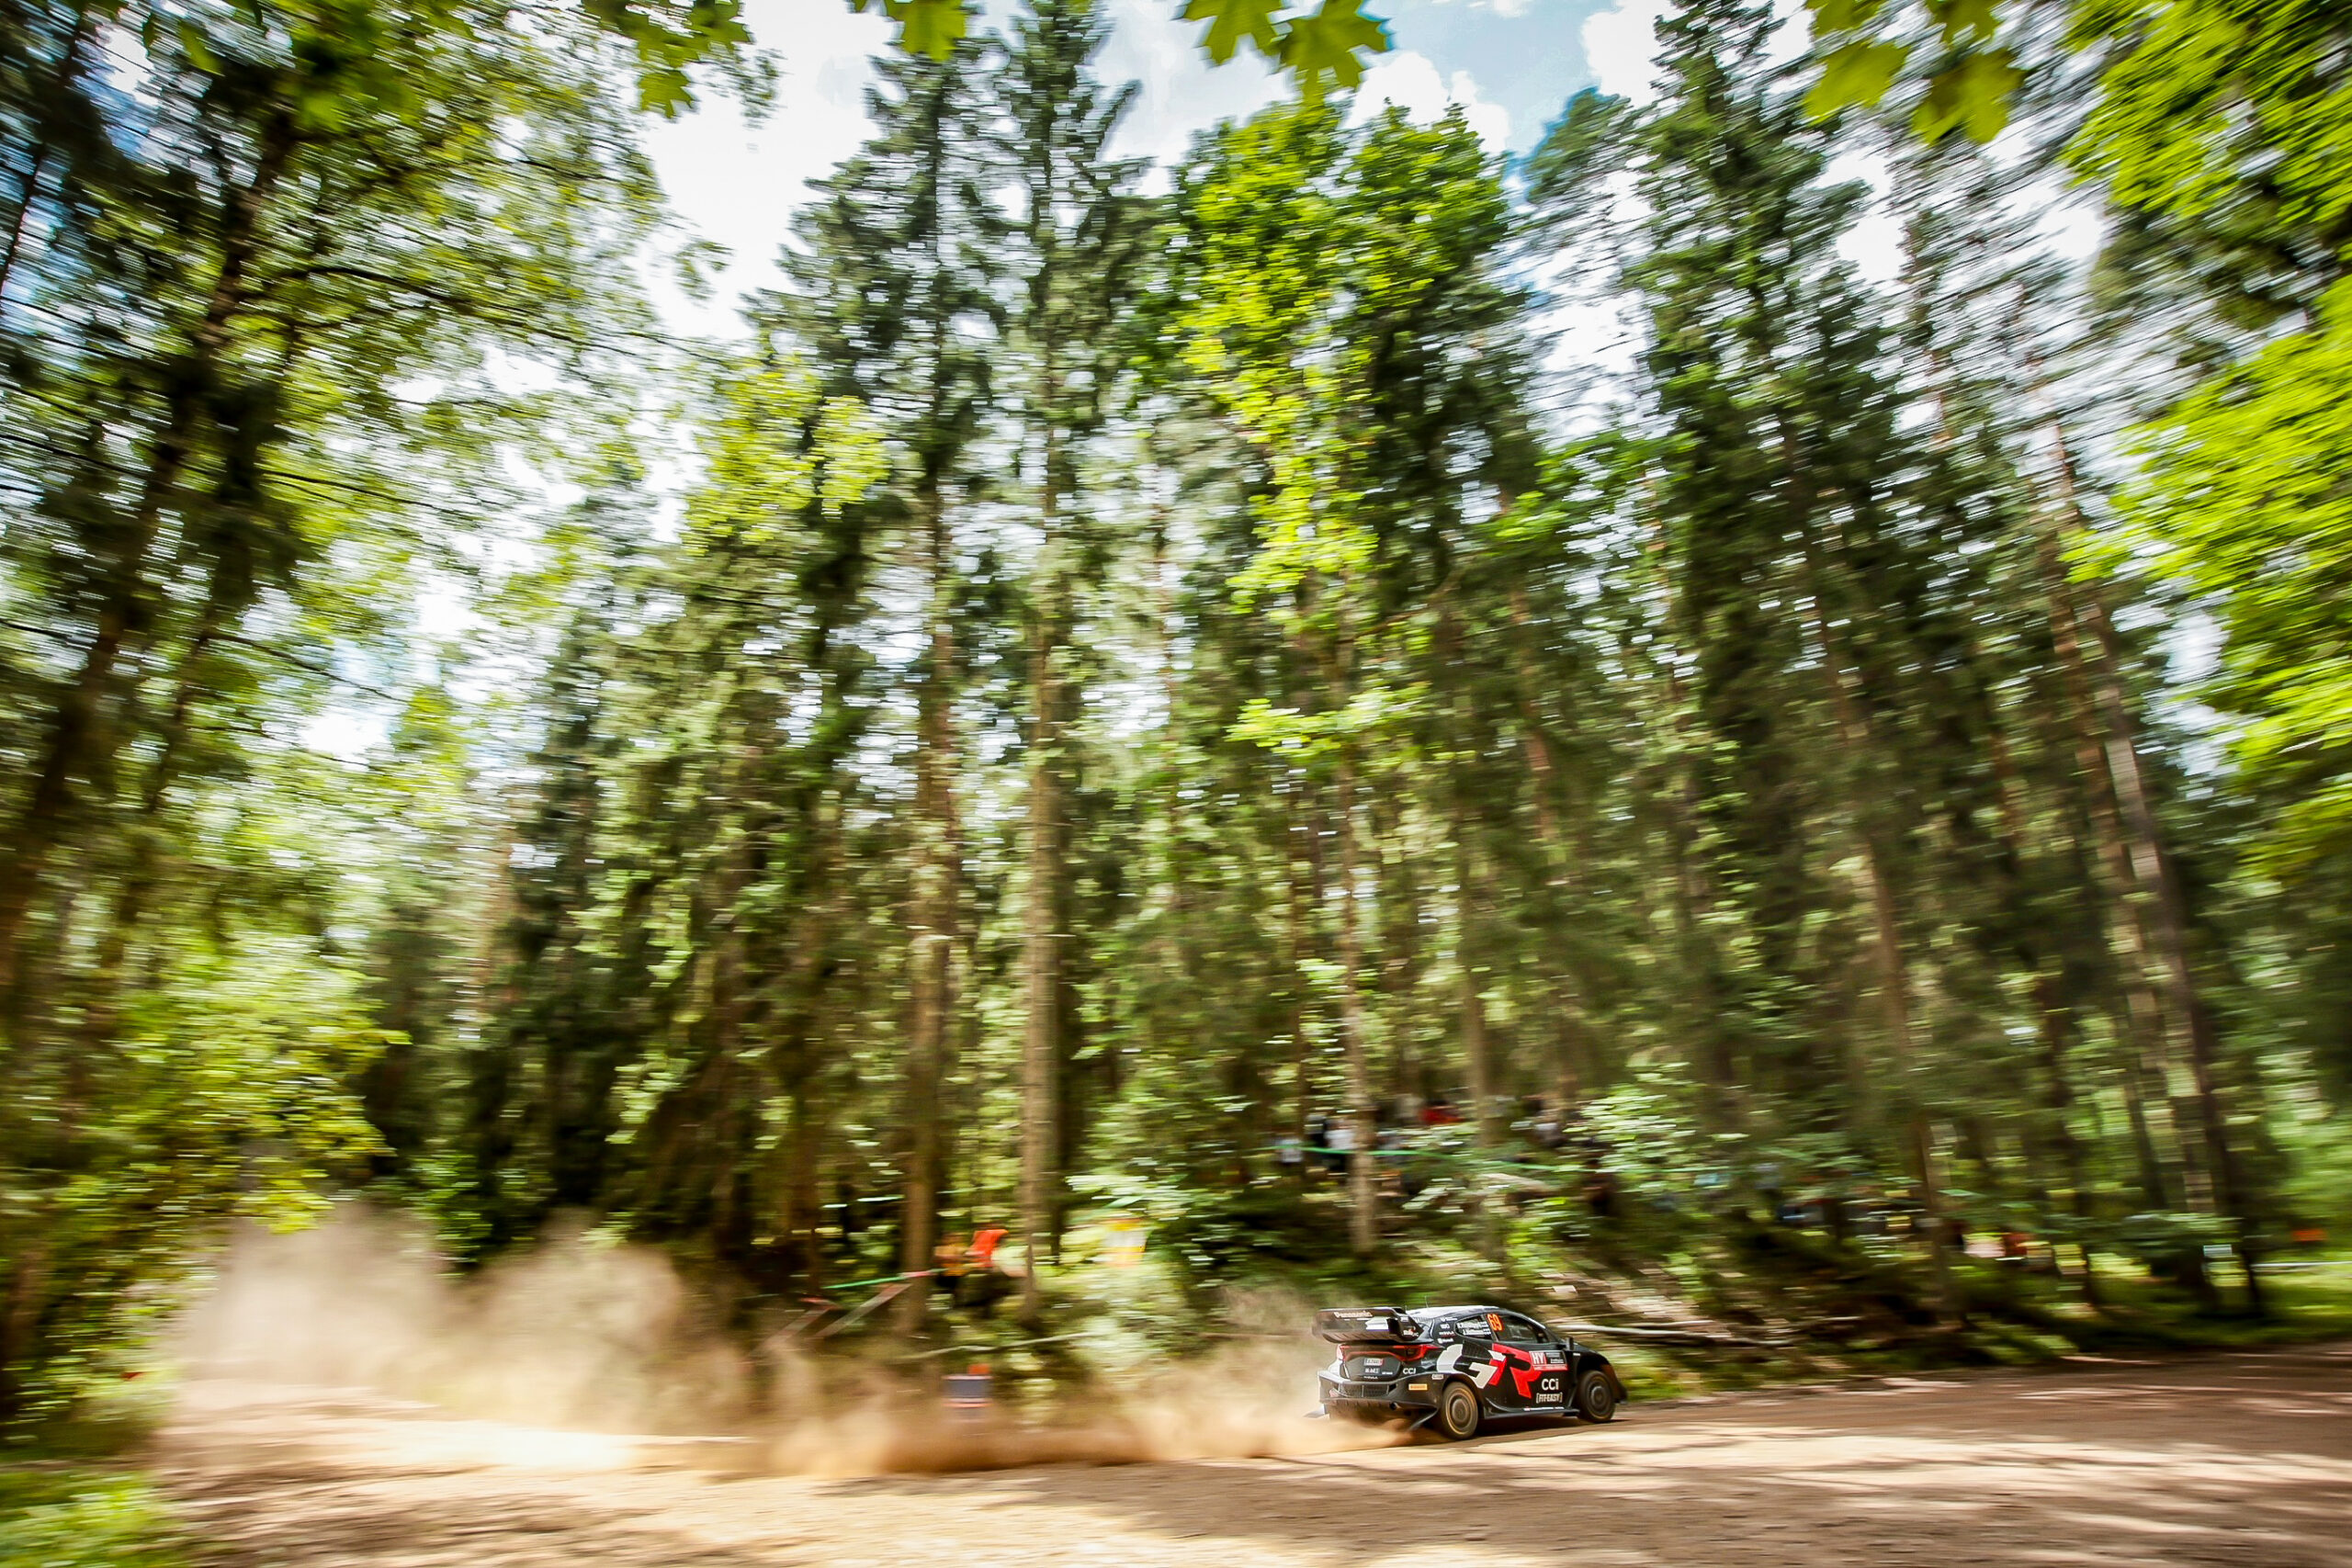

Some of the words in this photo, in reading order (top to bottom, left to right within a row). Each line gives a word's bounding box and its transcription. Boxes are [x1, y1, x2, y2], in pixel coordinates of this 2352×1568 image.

[1487, 1314, 1503, 1331] 69
[1531, 1352, 1544, 1365] HY
[1541, 1378, 1559, 1391] CCi
